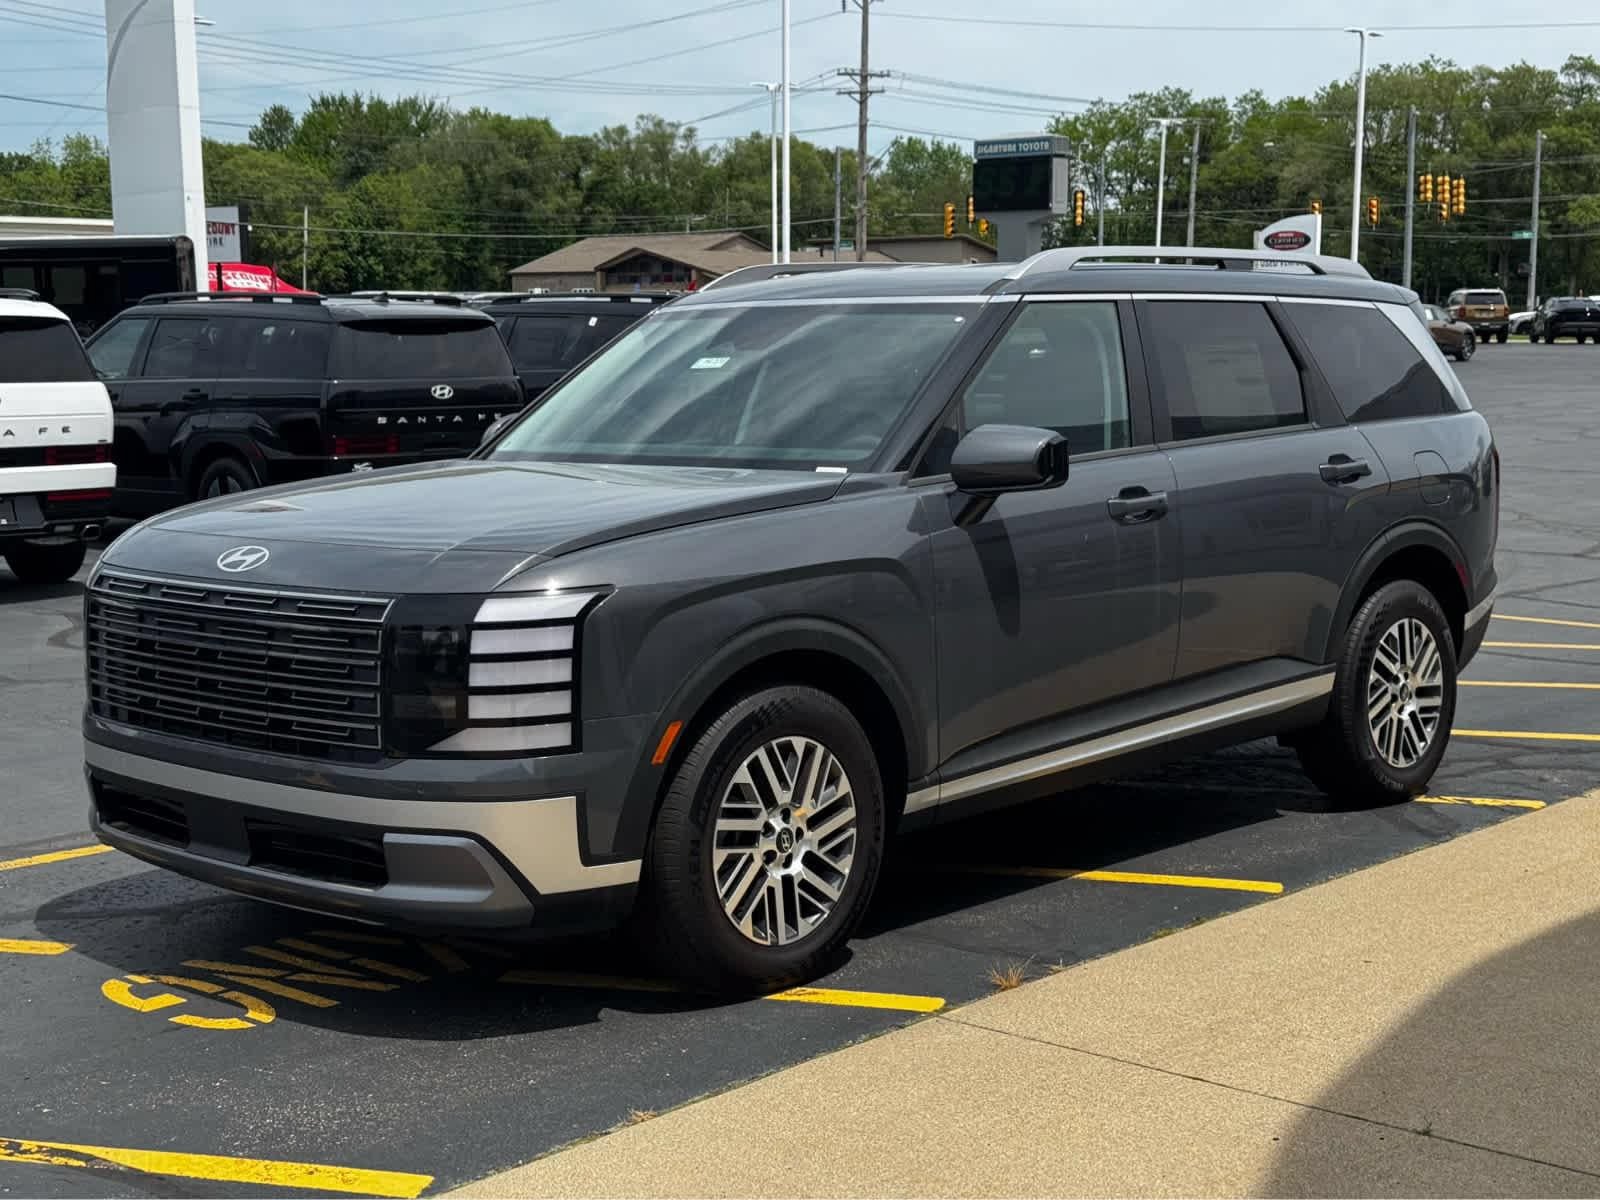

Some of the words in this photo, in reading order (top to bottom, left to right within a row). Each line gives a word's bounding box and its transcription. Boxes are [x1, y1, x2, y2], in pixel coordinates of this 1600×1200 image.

[206, 222, 236, 236] COUNT
[377, 415, 463, 424] SANTA
[38, 426, 72, 435] FE
